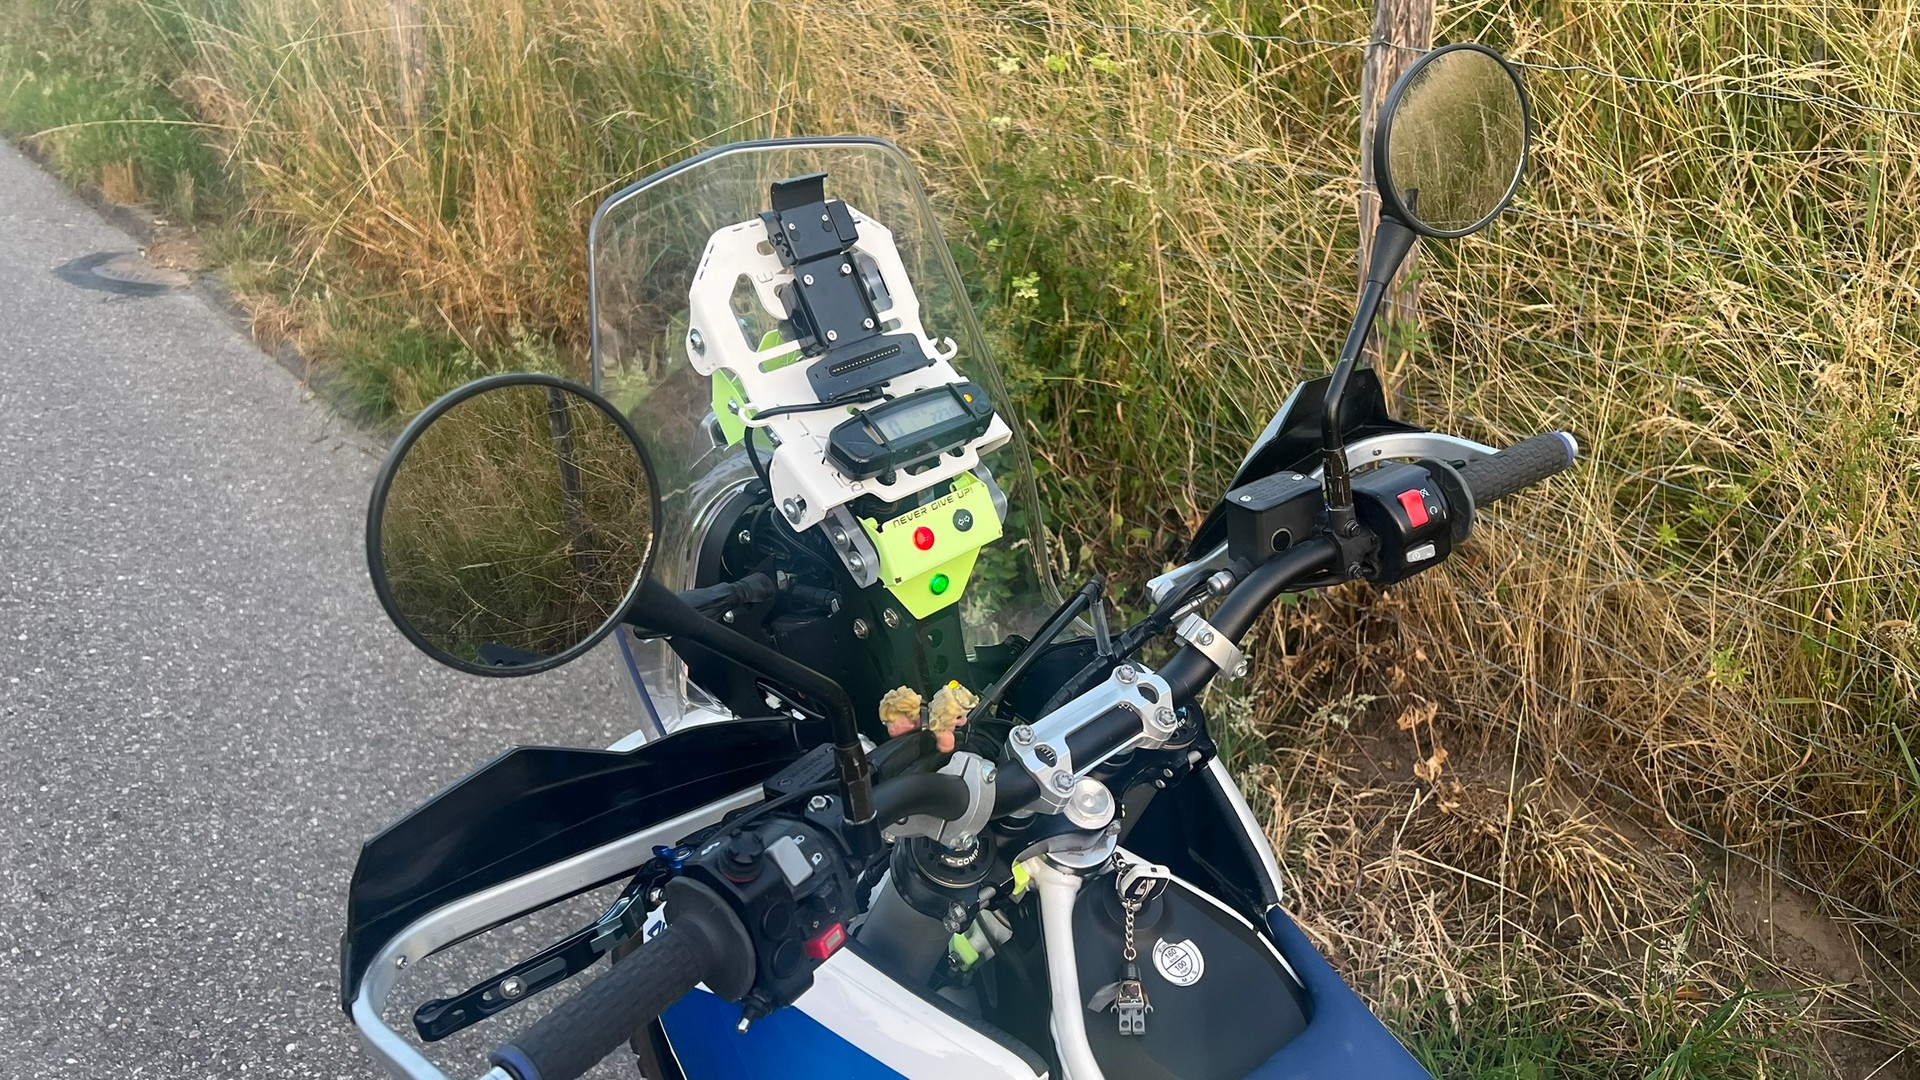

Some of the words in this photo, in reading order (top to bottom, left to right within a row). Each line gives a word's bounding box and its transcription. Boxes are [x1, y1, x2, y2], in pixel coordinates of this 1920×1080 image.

[892, 507, 928, 528] NEVER
[930, 495, 954, 511] GIVE
[957, 849, 979, 866] COMP
[1164, 948, 1177, 959] 160
[1174, 960, 1187, 971] 100
